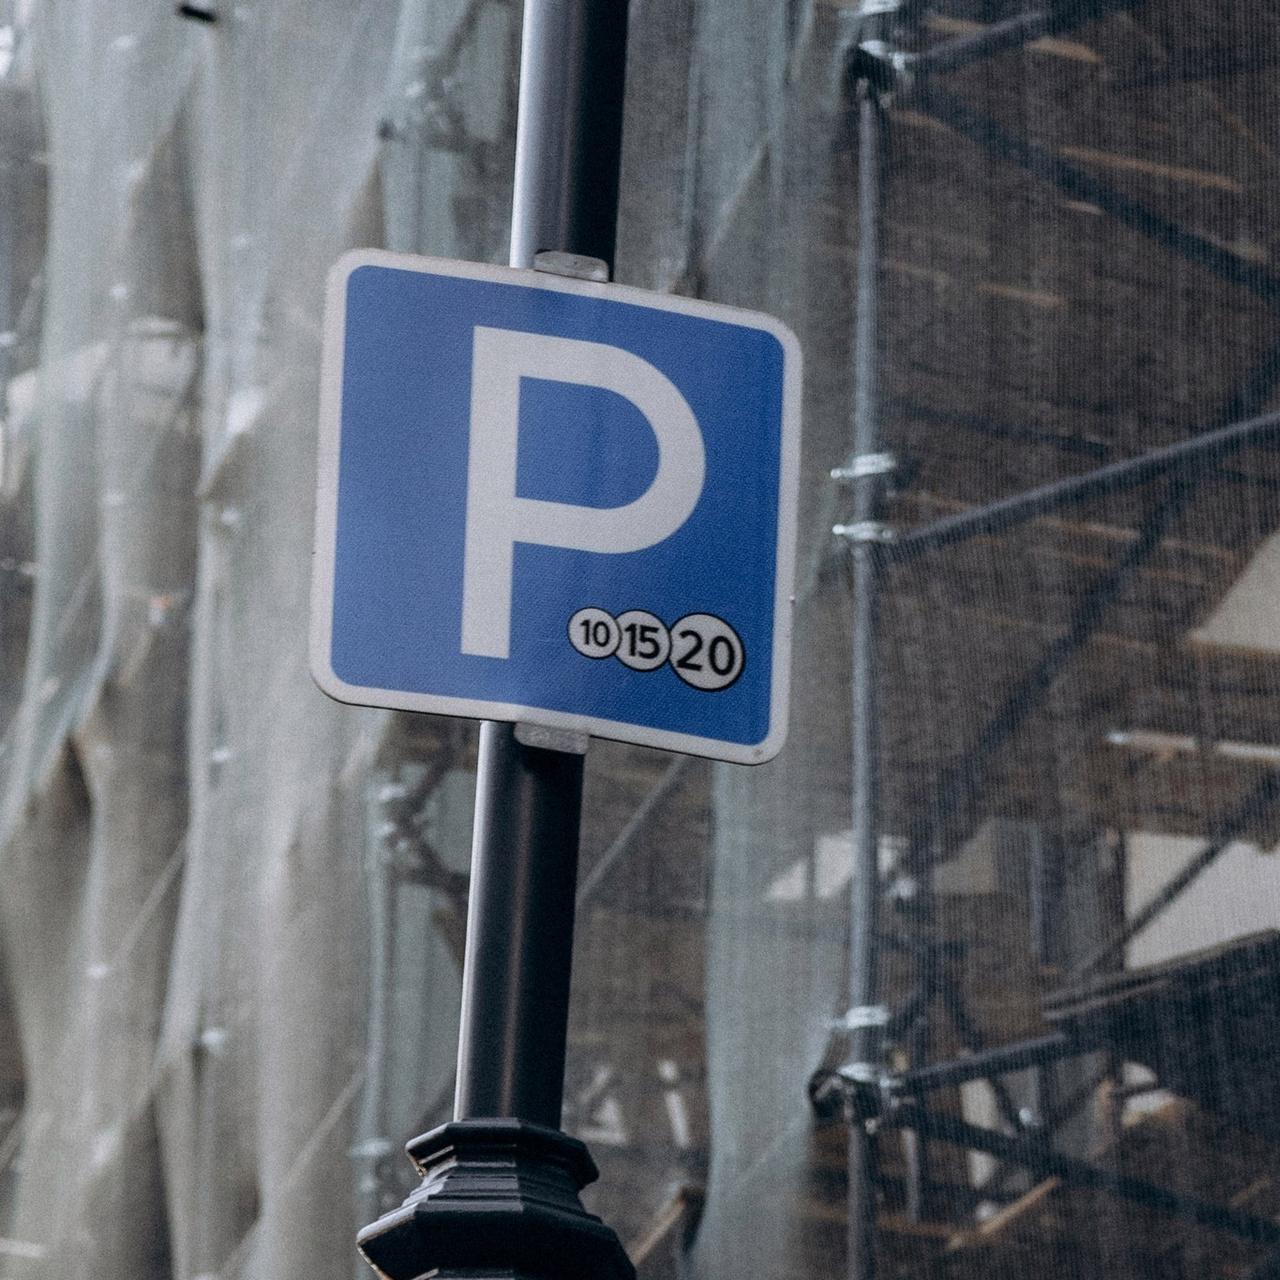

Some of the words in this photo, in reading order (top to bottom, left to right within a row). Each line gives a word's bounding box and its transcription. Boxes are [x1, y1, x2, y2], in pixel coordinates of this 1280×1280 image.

[461, 326, 706, 659] P
[580, 619, 611, 647] 10
[624, 623, 660, 659] 15
[677, 630, 735, 676] 20
